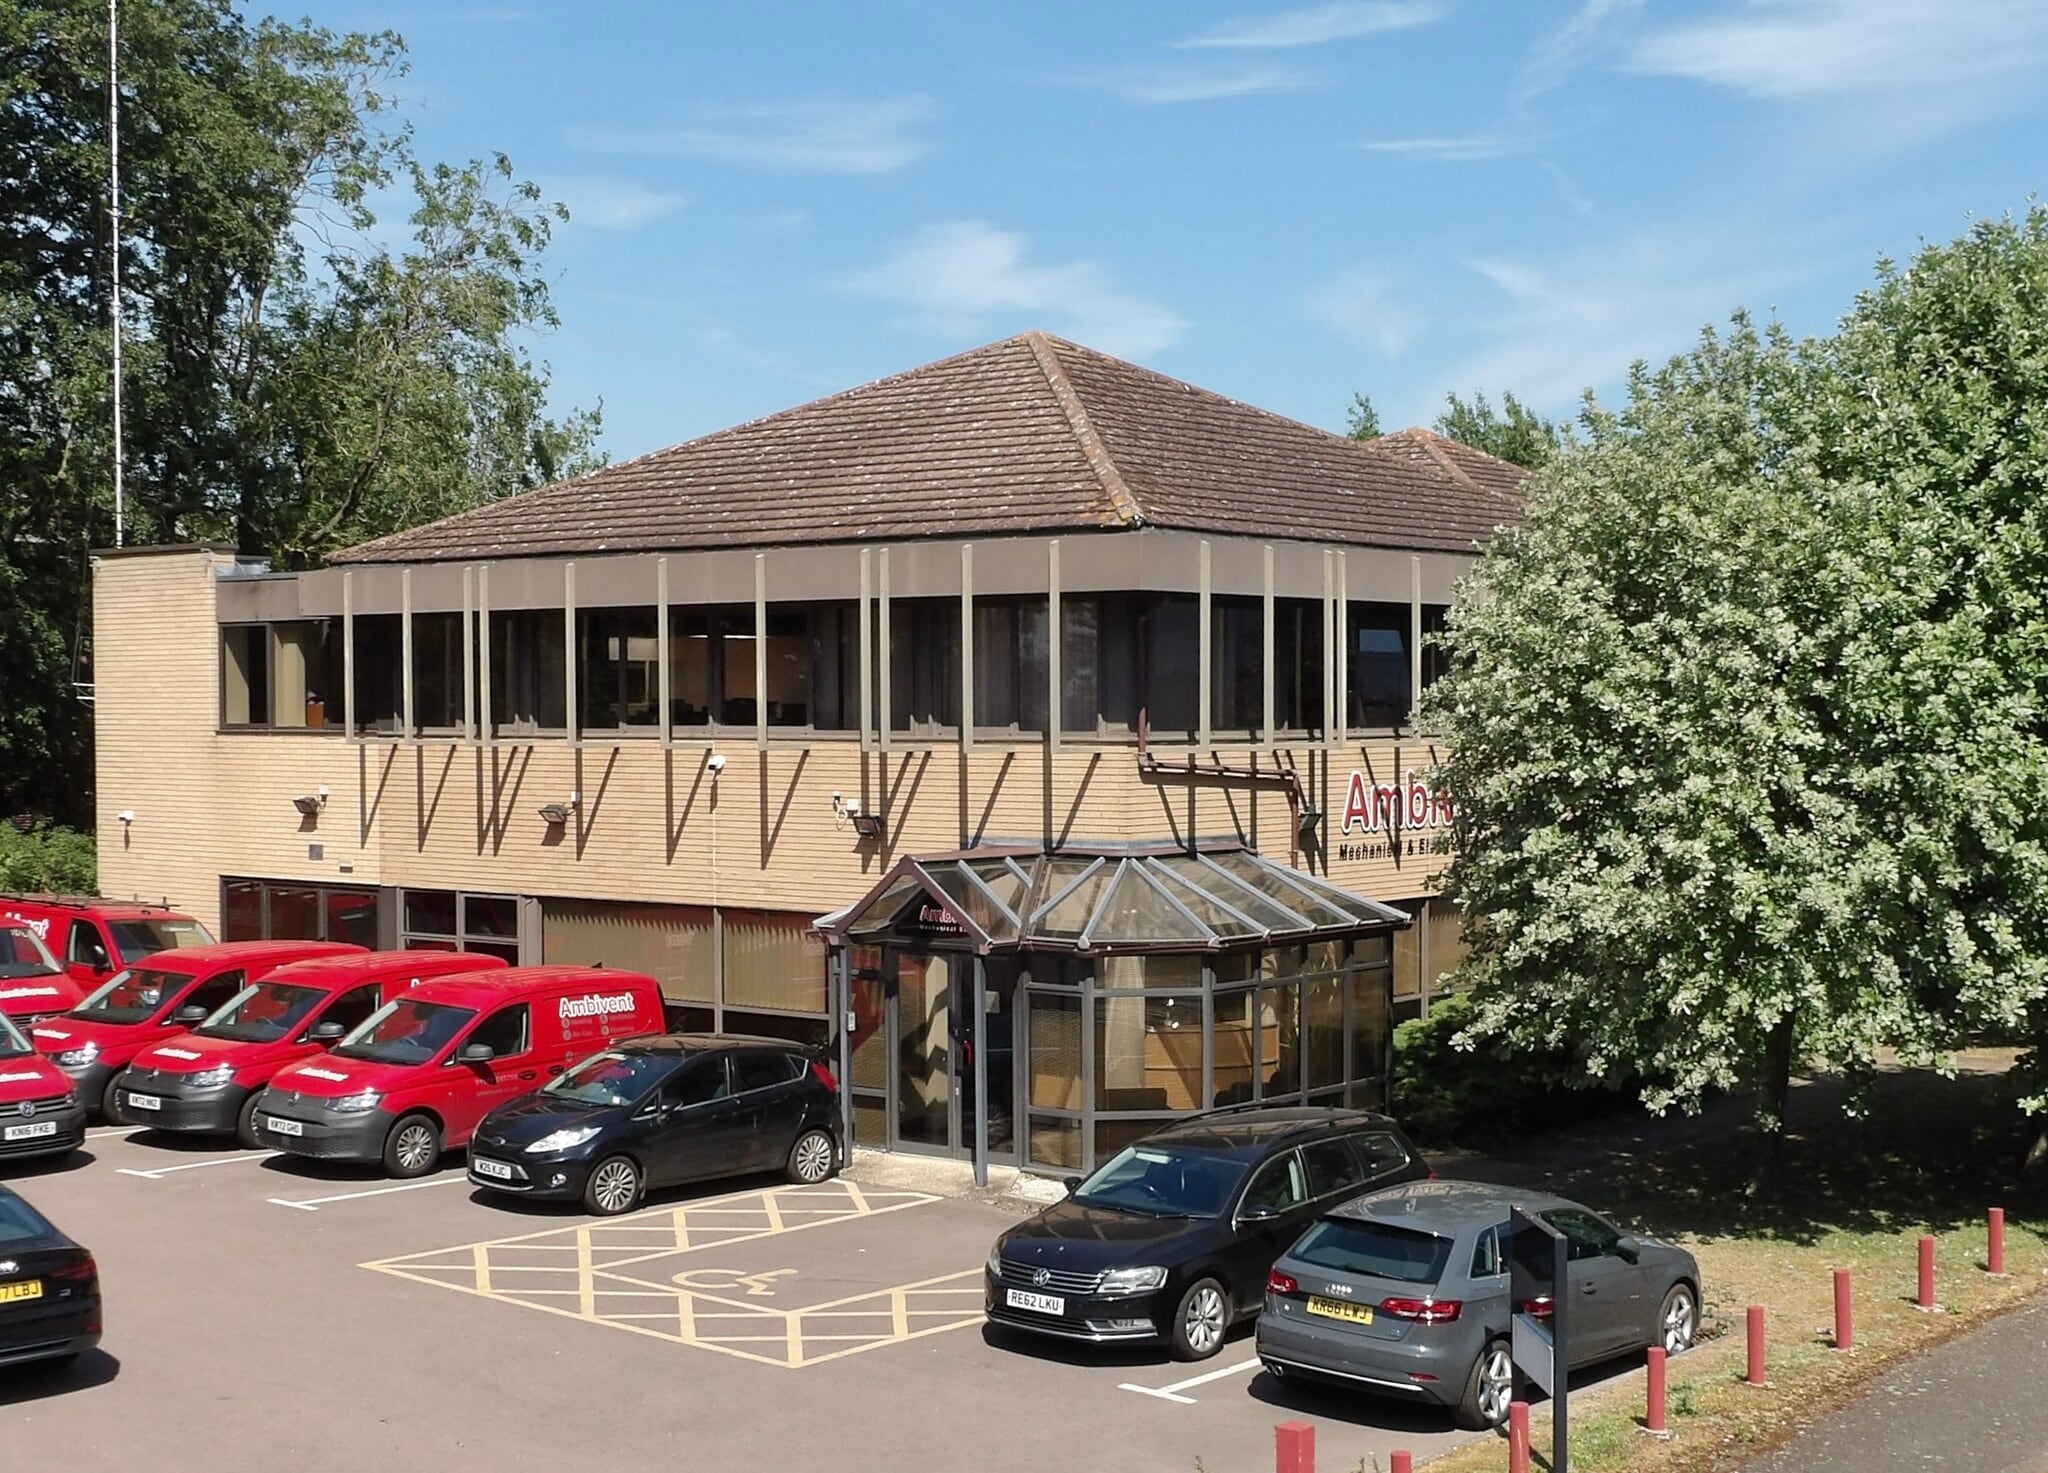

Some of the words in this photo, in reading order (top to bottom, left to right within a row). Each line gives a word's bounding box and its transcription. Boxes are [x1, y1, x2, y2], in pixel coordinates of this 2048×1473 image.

[559, 992, 636, 1018] Ambivent
[14, 1281, 39, 1298] LBJ
[1011, 1292, 1037, 1308] RE62
[1039, 1297, 1059, 1311] LKU
[1312, 1297, 1342, 1315] KR66
[1344, 1303, 1368, 1320] LWJ
